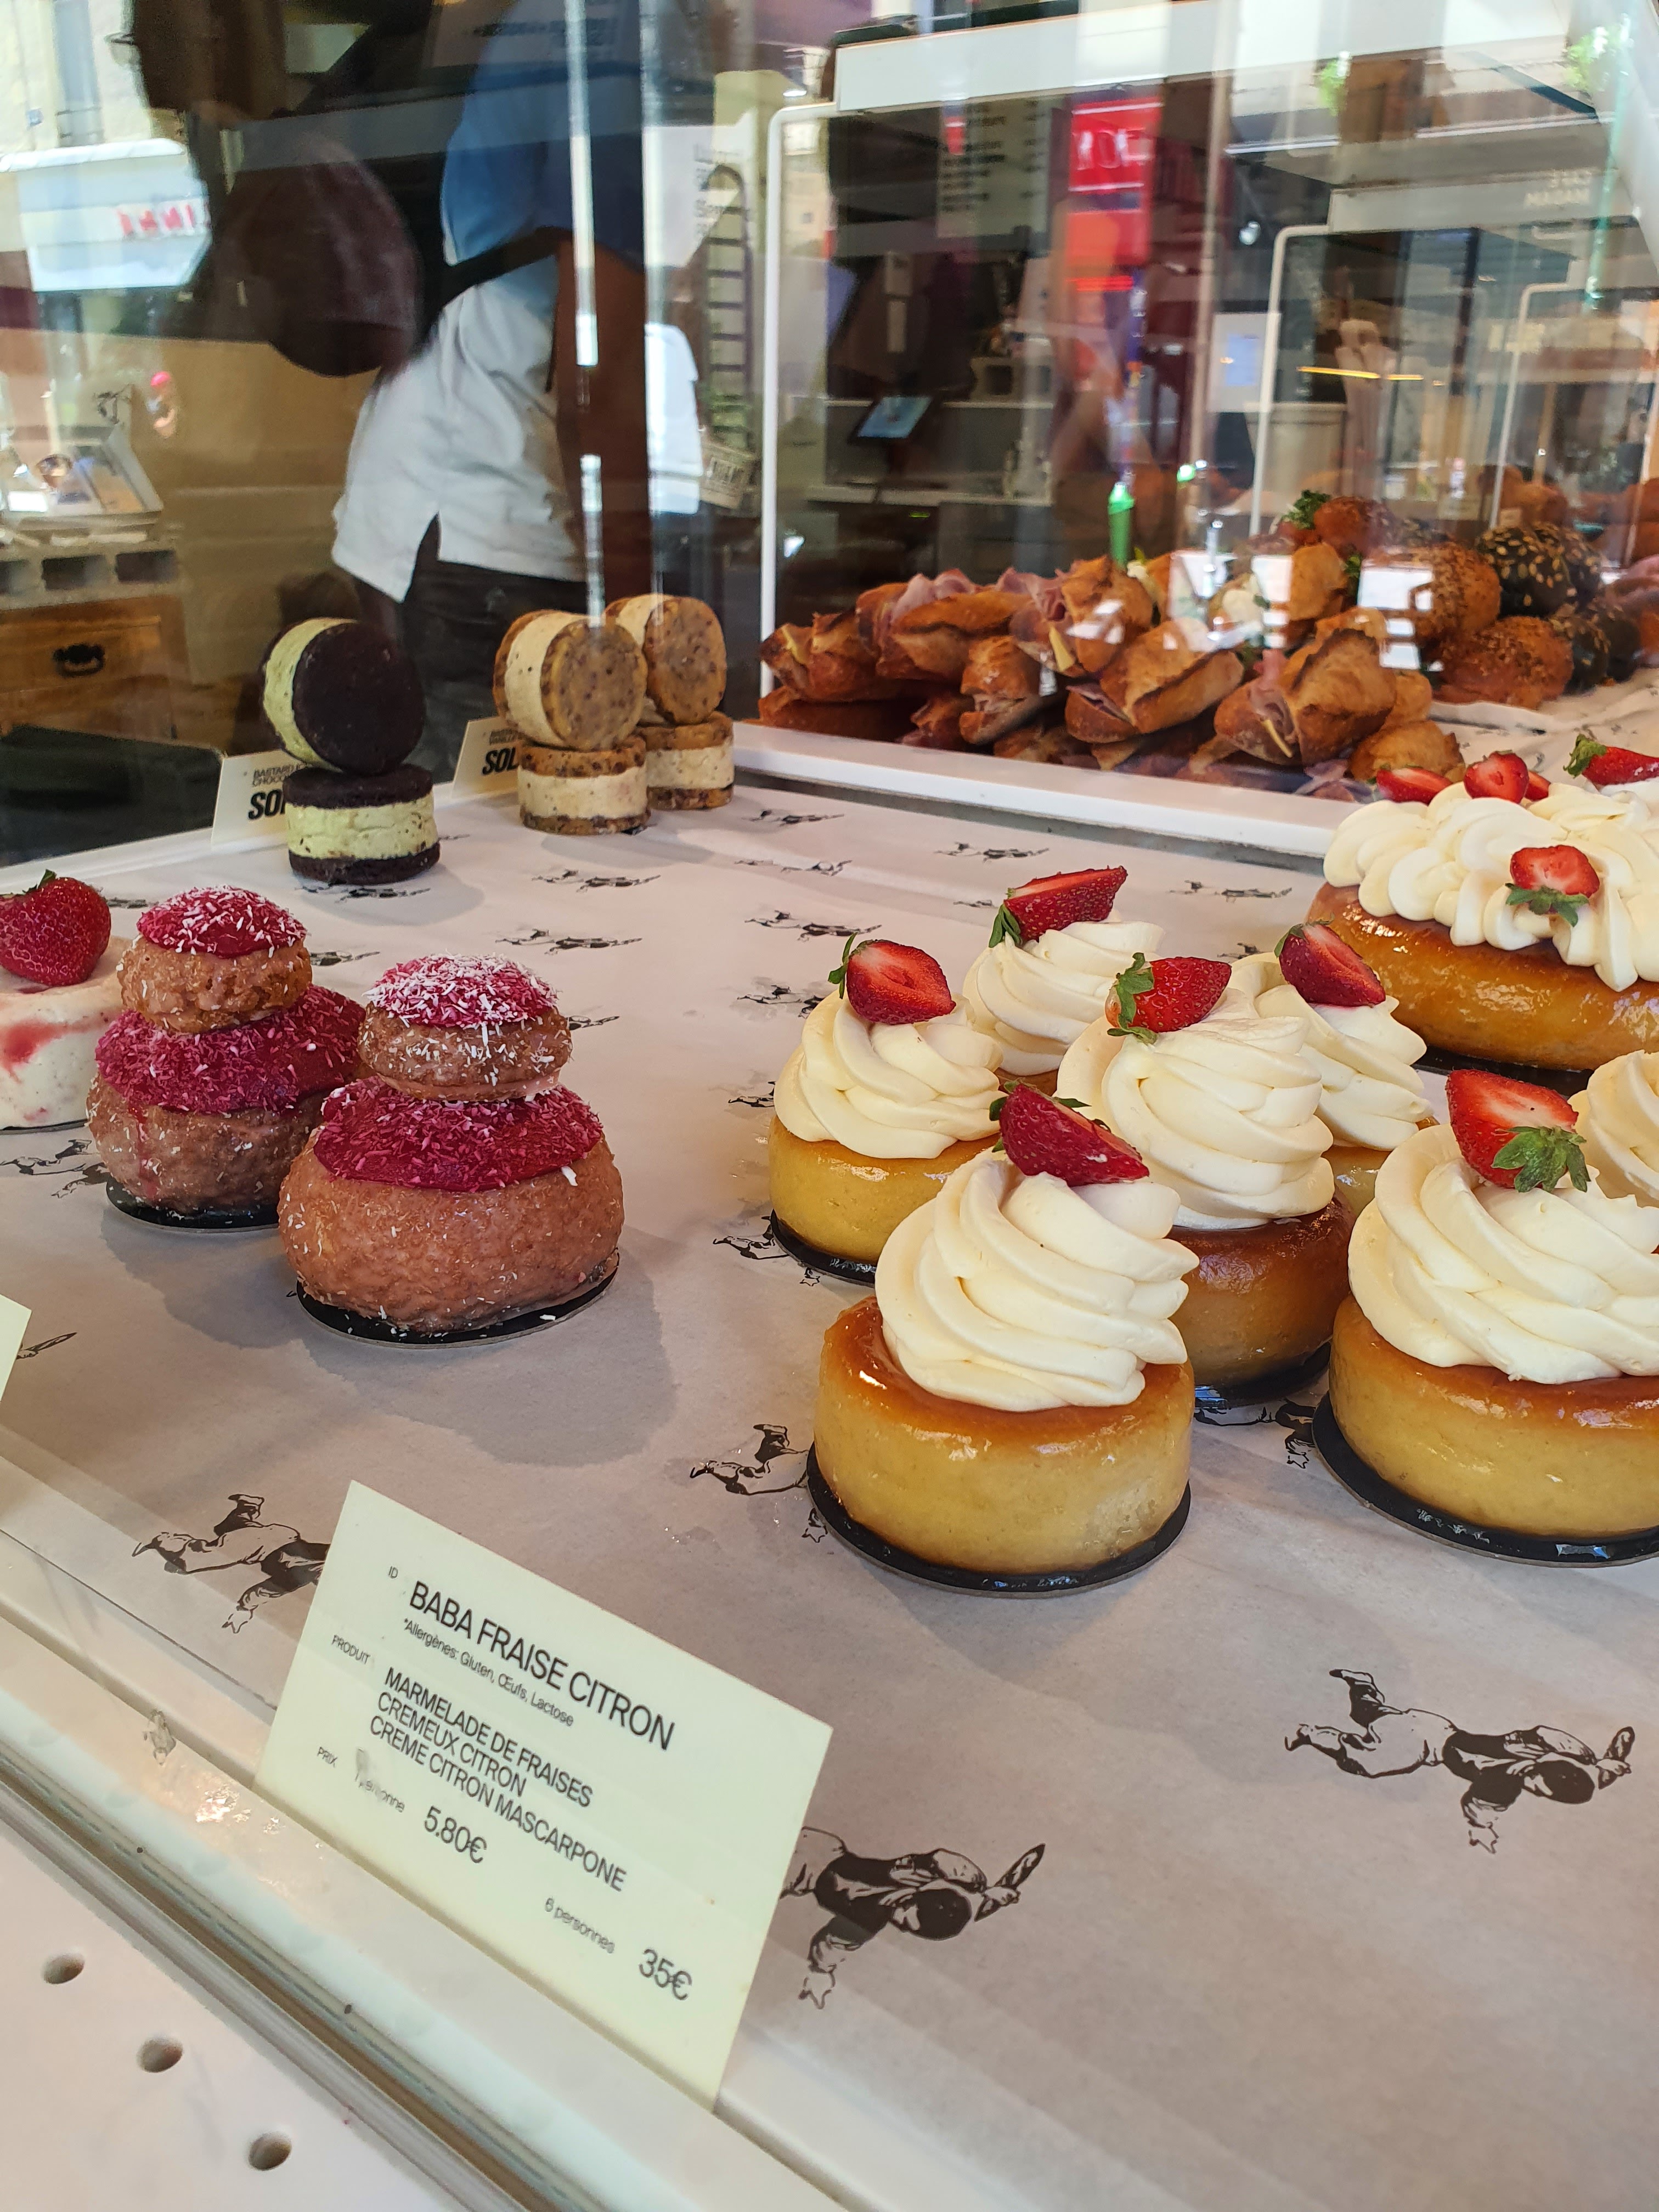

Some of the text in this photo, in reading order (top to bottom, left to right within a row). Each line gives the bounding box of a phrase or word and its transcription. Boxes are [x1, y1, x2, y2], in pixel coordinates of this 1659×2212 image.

[482, 747, 519, 775] SOL
[388, 1566, 399, 1579] ID
[331, 1634, 370, 1664] PRODUIT
[410, 1581, 675, 1750] BABA FRAISE CITRON
[460, 1651, 494, 1684] Gluten,
[531, 1691, 574, 1726] Lactose
[317, 1746, 338, 1768] PRIX
[378, 1691, 527, 1798] CREMEUX CITRON
[385, 1666, 592, 1807] MARMELADE DE FRAISES
[359, 1780, 405, 1813] peonne
[370, 1716, 627, 1892] CREME CITRON MASCARPONE
[424, 1806, 487, 1864] 5.80€
[553, 1906, 615, 1954] personnes
[639, 1948, 692, 2001] 35€
